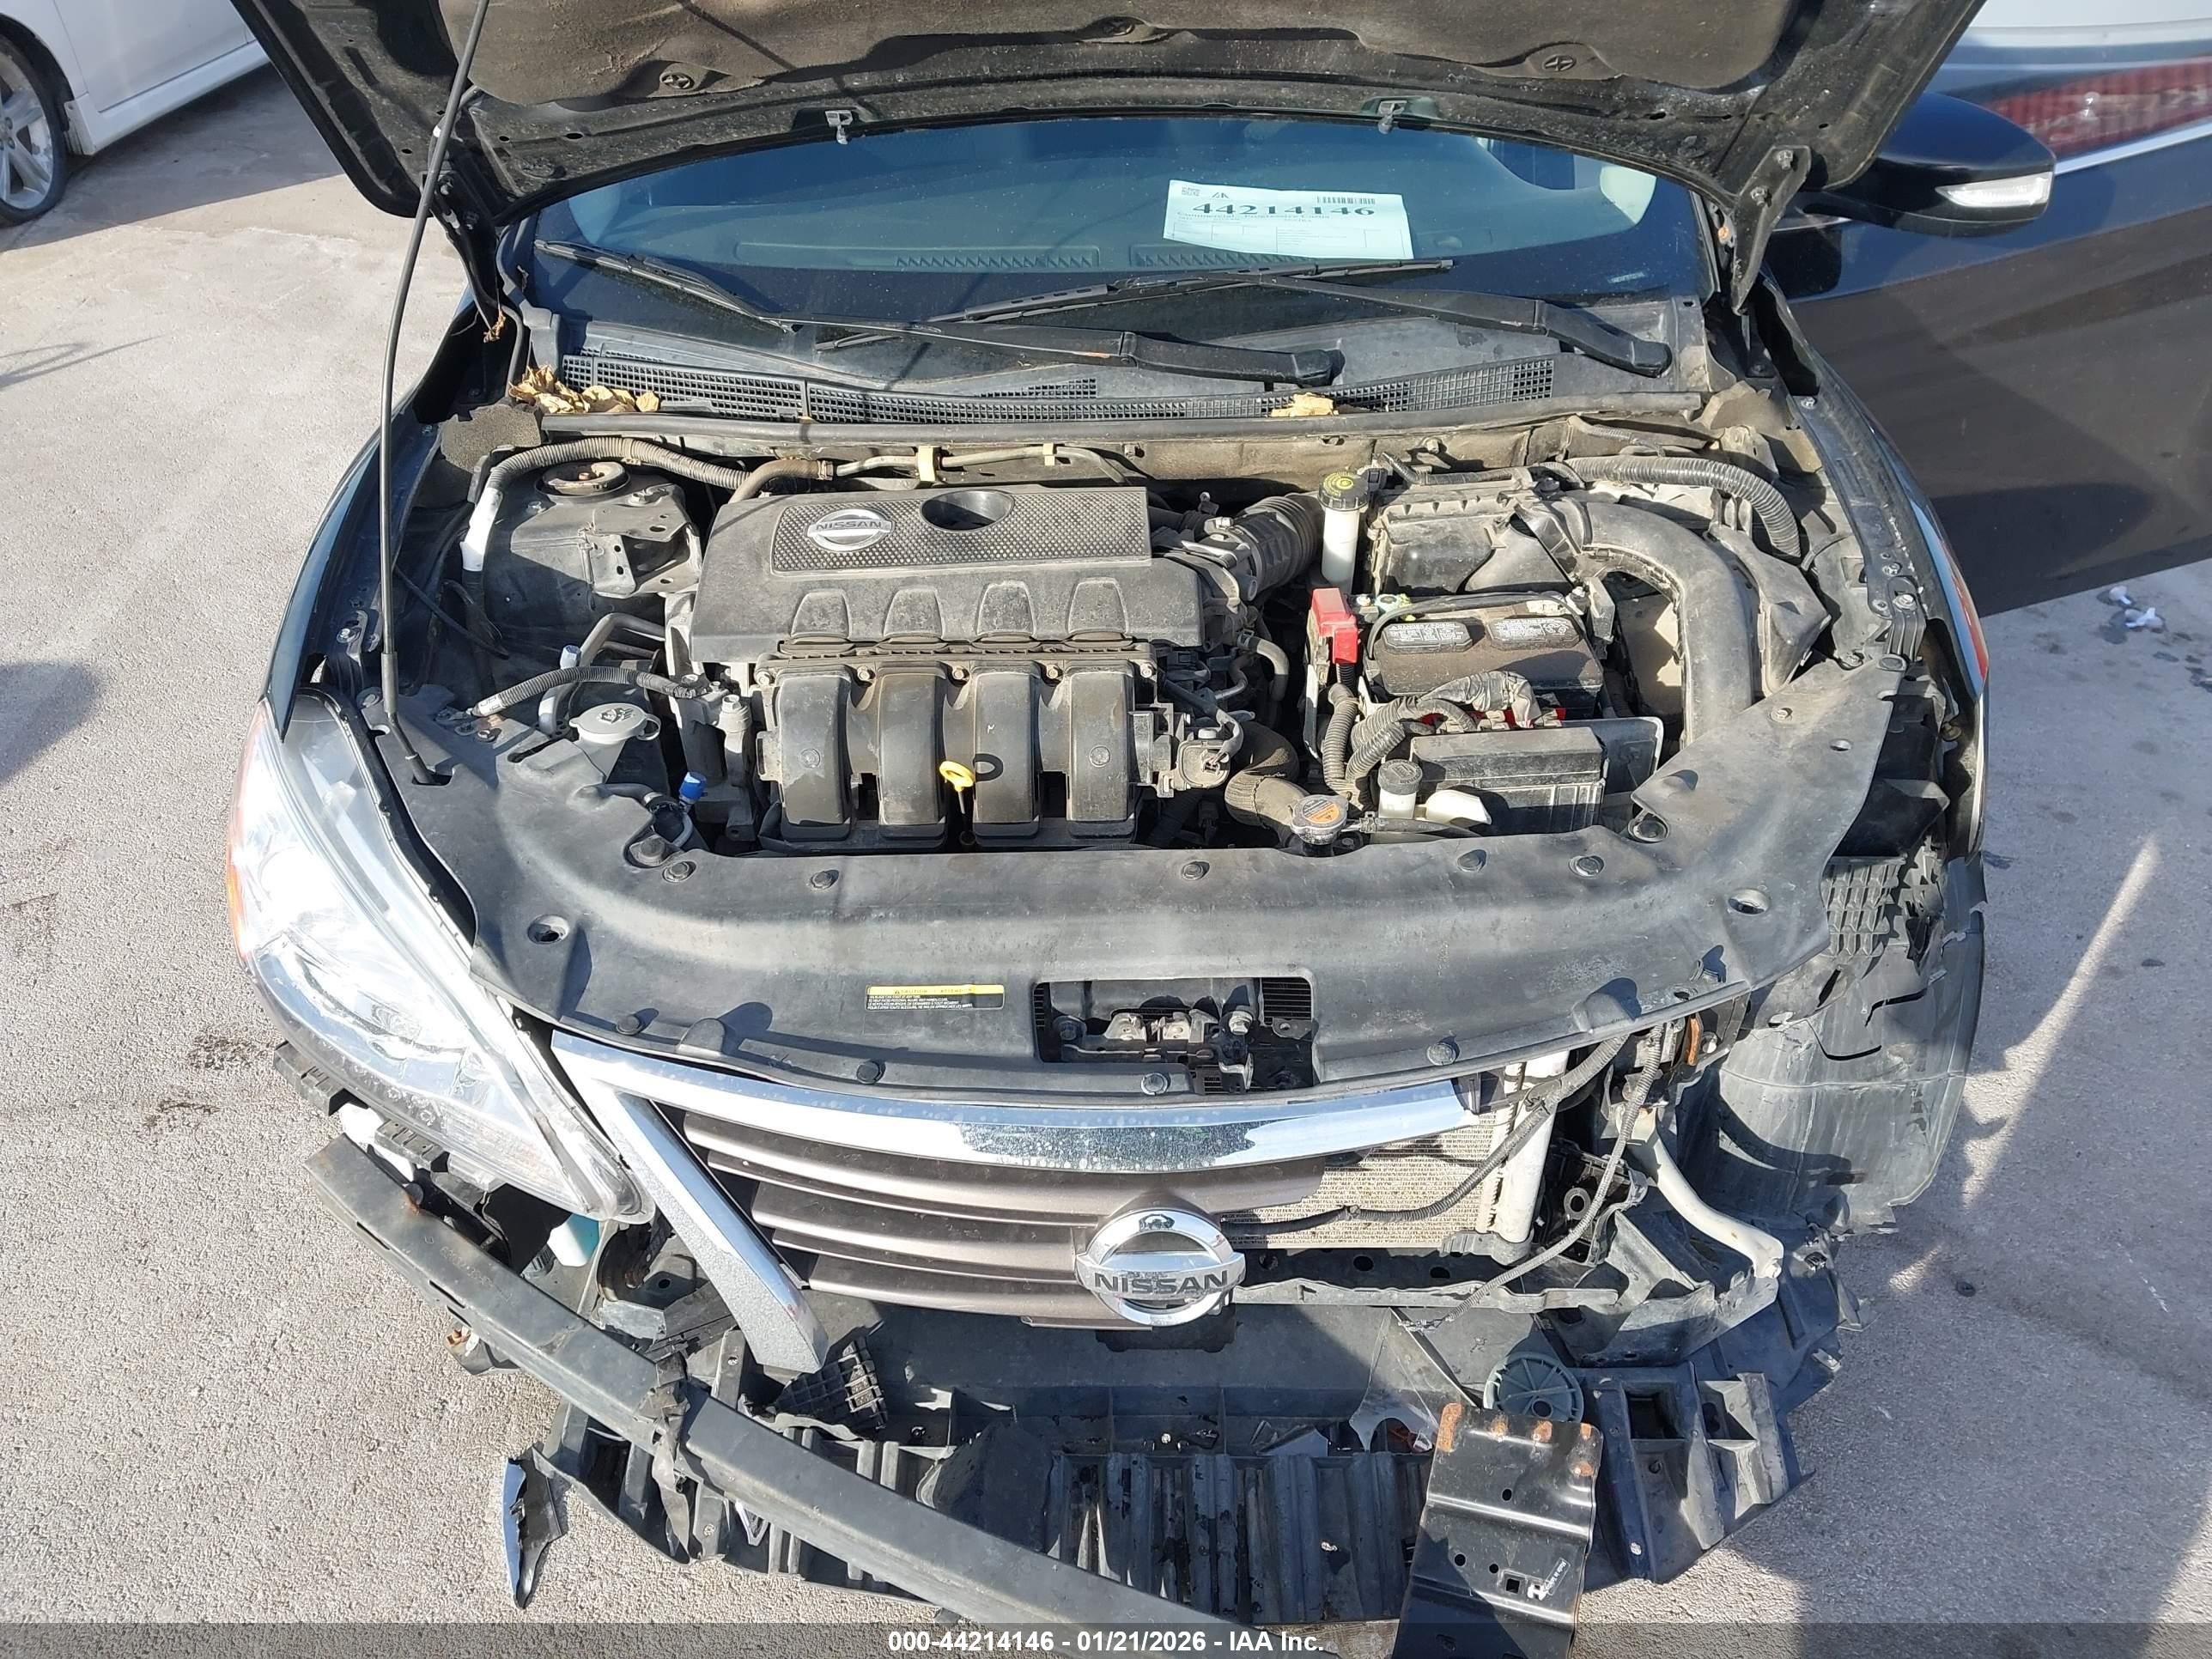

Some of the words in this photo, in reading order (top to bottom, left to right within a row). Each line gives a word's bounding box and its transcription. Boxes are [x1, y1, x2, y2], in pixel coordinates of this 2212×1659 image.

[1193, 203, 1375, 216] 44214146
[817, 521, 882, 530] NISSAN
[1094, 1269, 1229, 1295] NISSAN
